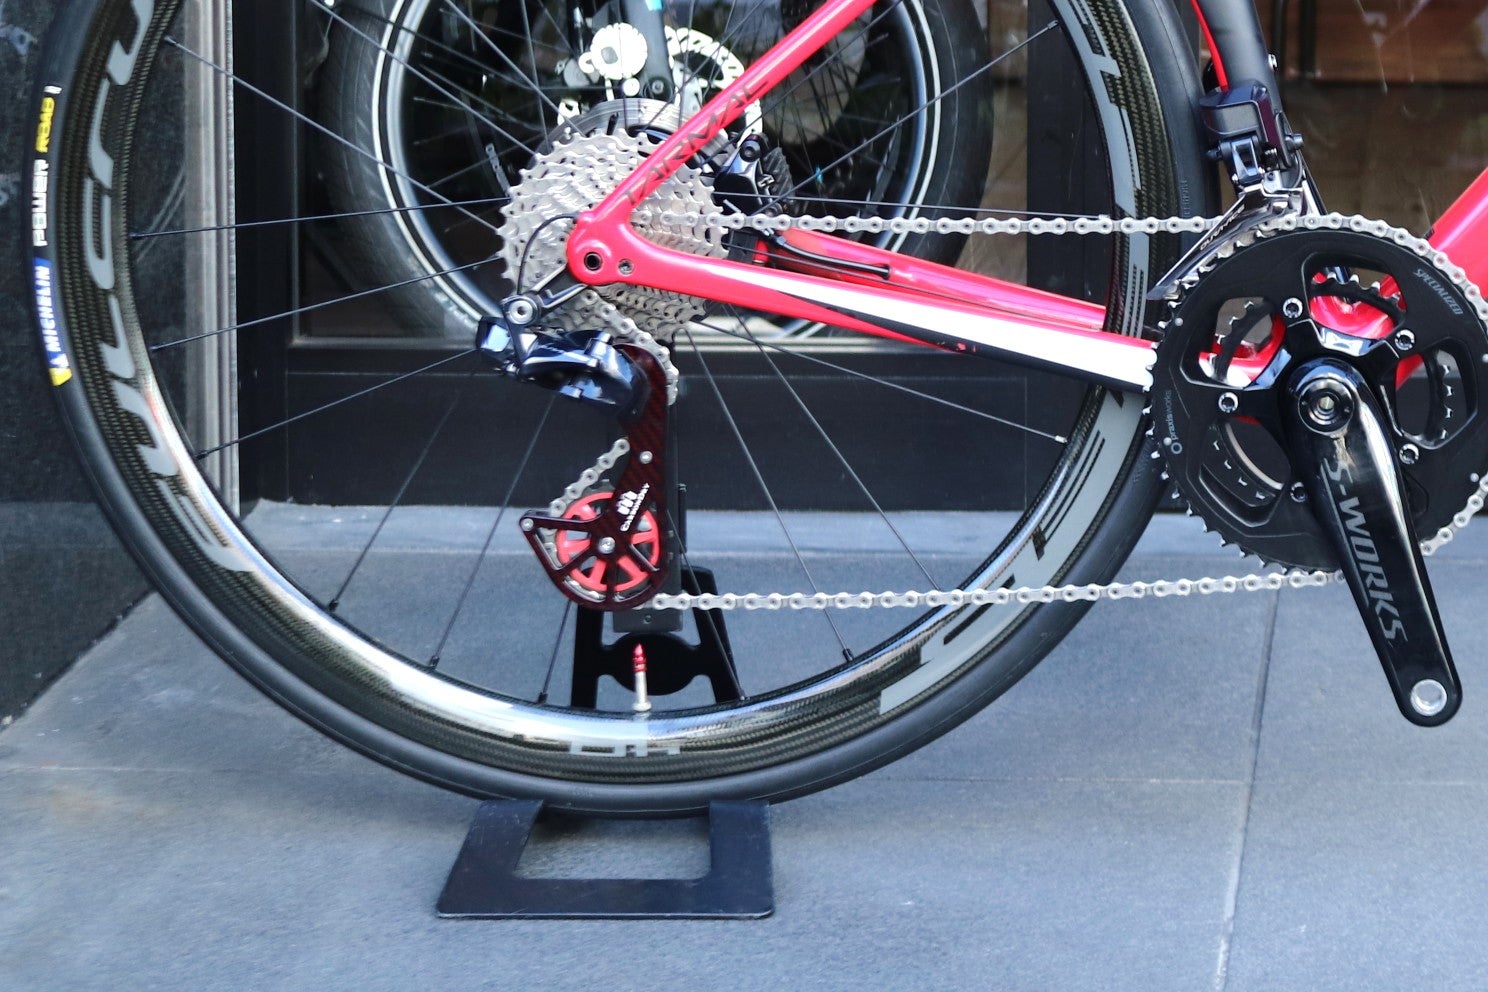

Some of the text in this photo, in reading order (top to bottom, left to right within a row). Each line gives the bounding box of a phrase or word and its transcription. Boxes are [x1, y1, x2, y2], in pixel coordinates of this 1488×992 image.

[32, 97, 62, 352] MICHELIN POWER ROAD
[1413, 269, 1463, 315] SPECIALIZED
[1324, 457, 1408, 642] S-WORKS
